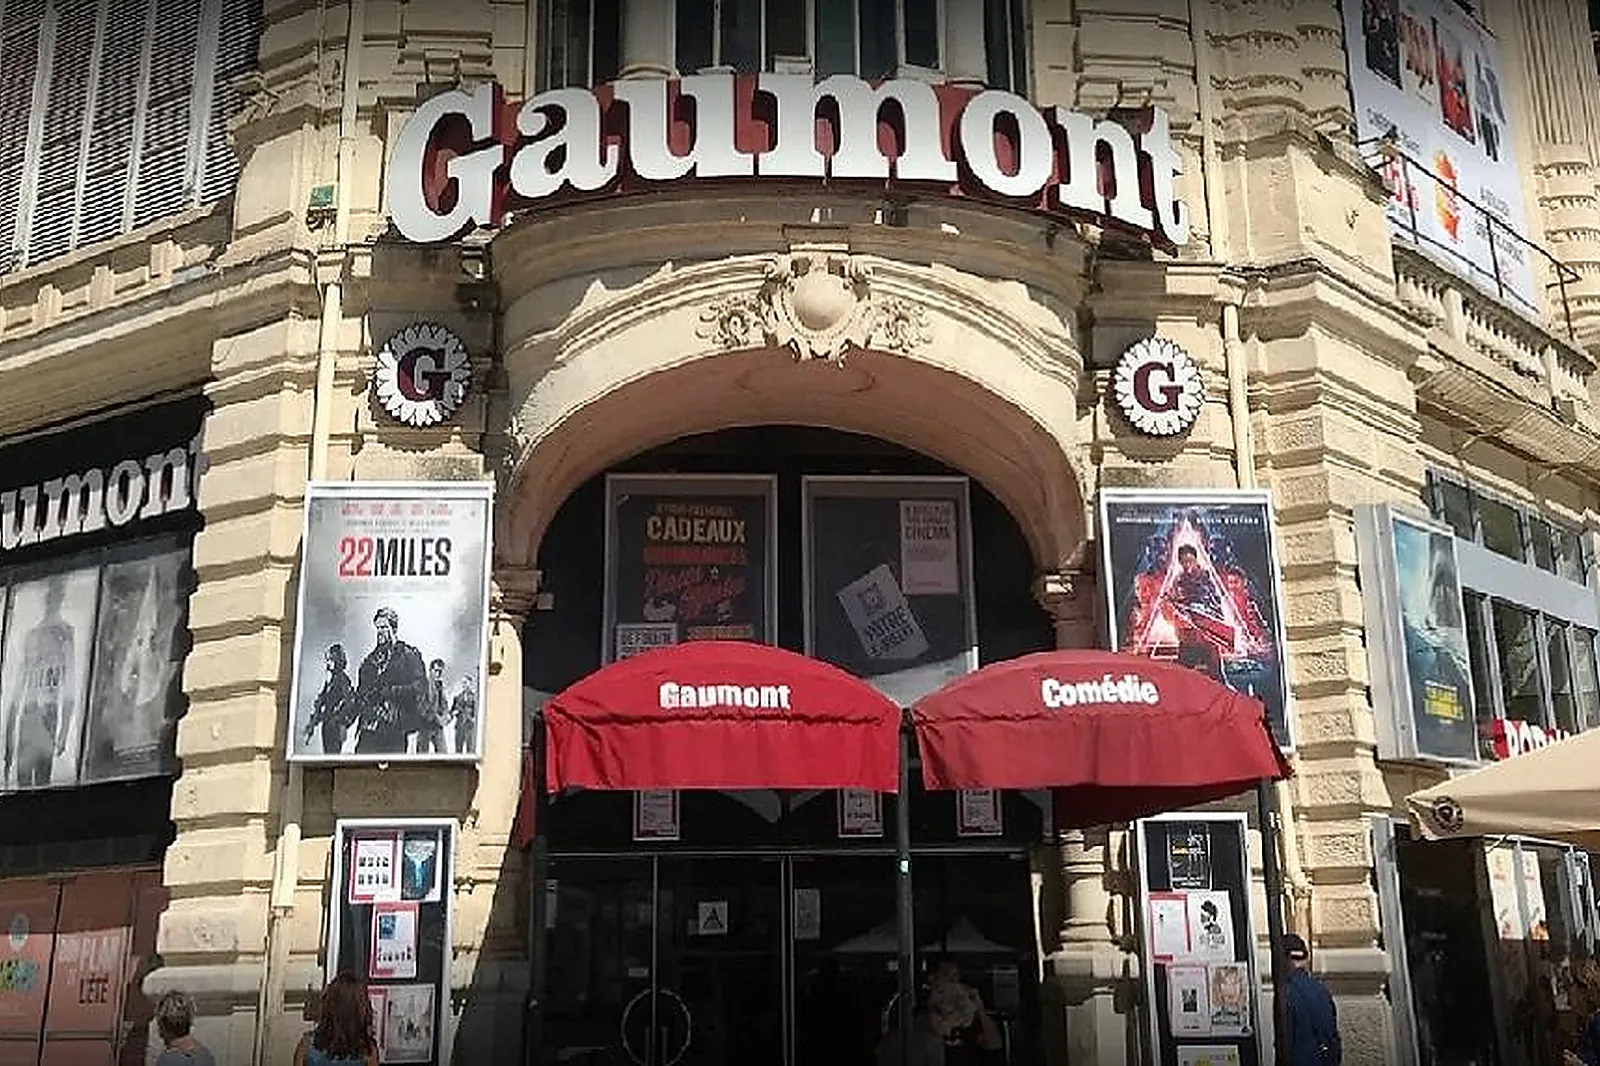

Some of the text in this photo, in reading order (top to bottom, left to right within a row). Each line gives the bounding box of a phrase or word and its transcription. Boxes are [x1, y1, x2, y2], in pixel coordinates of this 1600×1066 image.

[387, 74, 1190, 246] Gaumont
[397, 347, 452, 402] G
[1133, 361, 1184, 413] G
[646, 516, 746, 543] CADEAUX
[659, 682, 791, 709] Gaumont
[1042, 674, 1159, 707] Comédie
